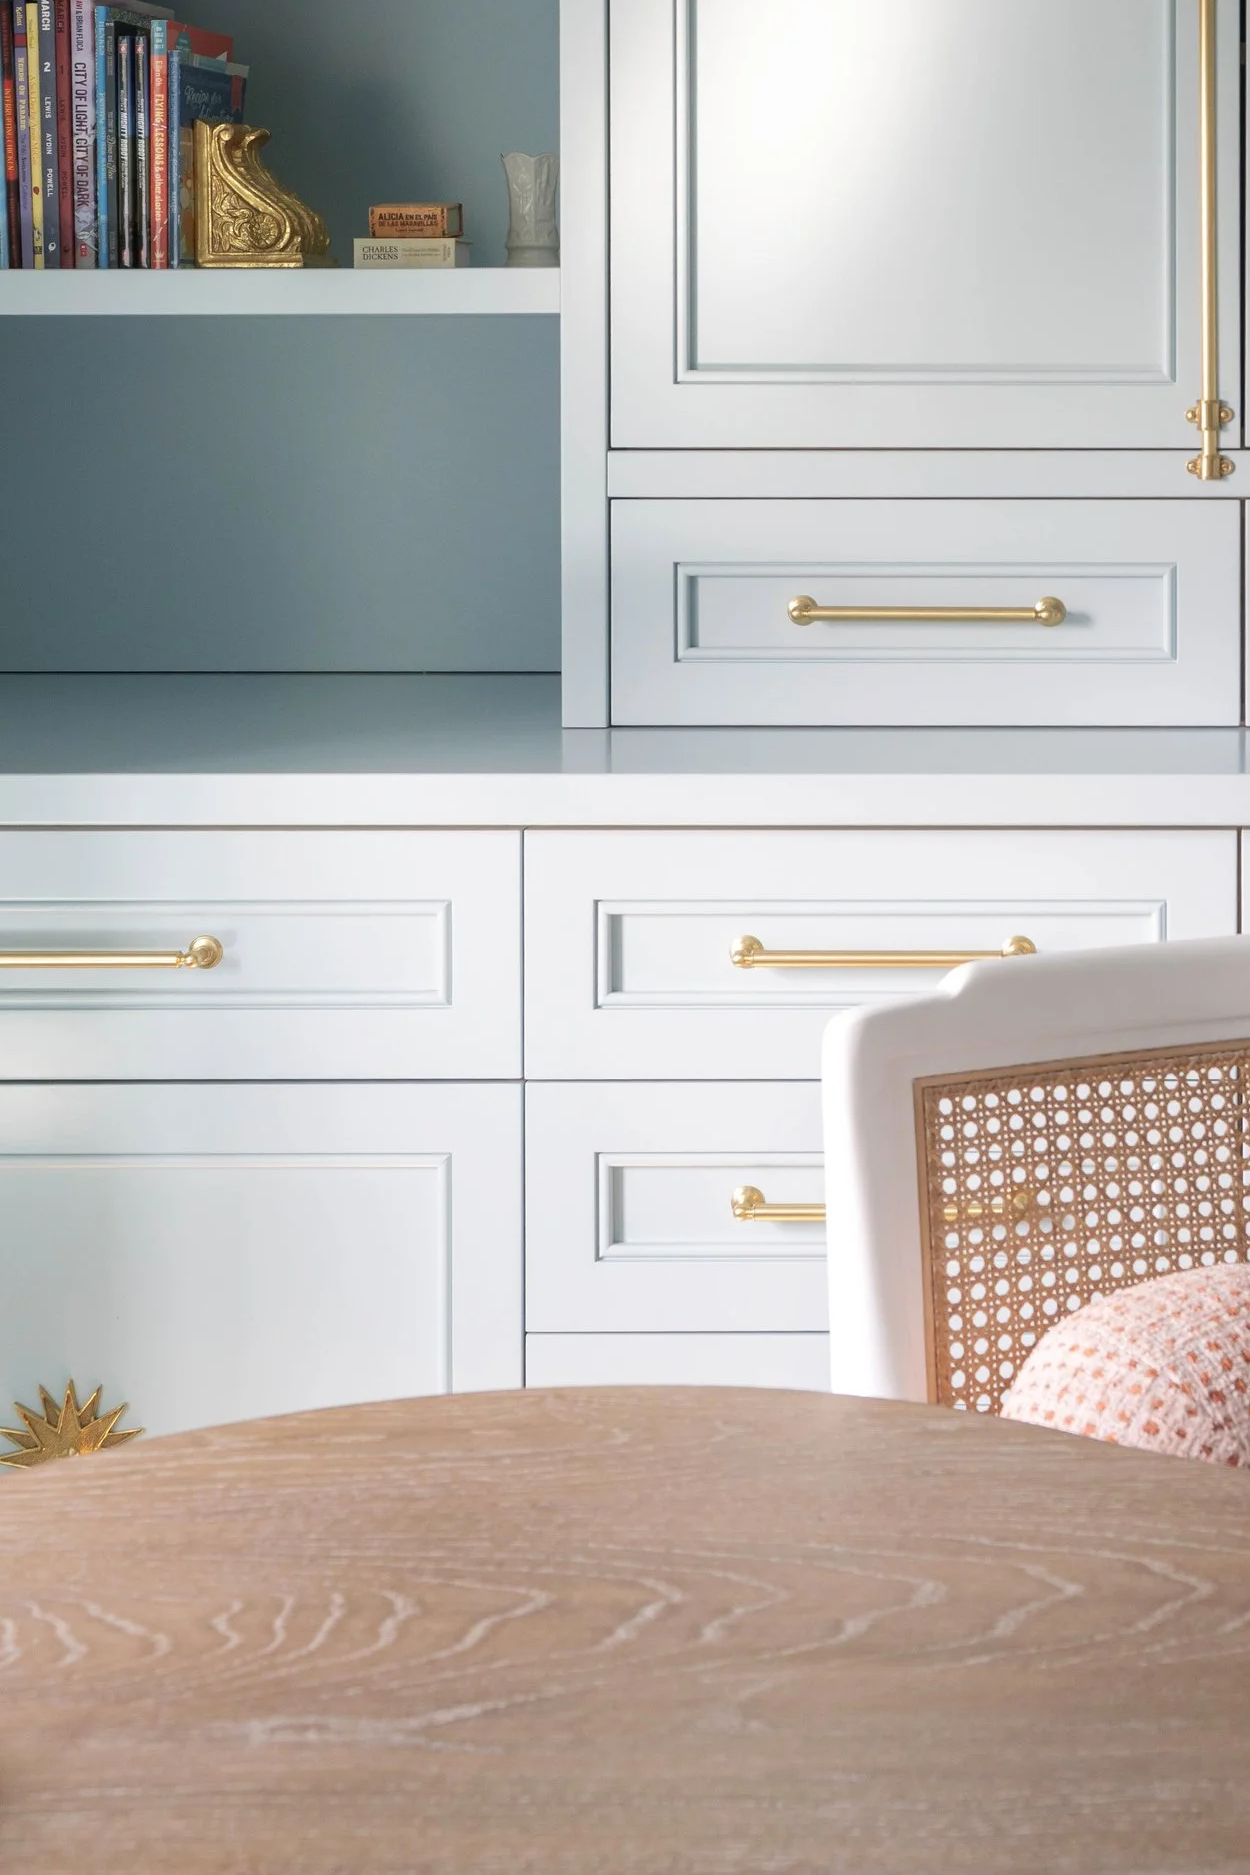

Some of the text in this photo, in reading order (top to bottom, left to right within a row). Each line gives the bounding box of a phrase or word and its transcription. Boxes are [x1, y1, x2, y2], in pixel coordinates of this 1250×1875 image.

[75, 0, 83, 10] AVI
[56, 0, 65, 34] MARCH
[75, 15, 83, 33] BRIAN
[75, 33, 84, 52] FLOCA
[43, 62, 51, 72] 2
[155, 60, 163, 76] Ellen
[155, 77, 163, 86] Oh
[44, 97, 52, 119] LEWIS
[155, 93, 164, 123] FLYING
[74, 62, 90, 207] CITY OF LIGHT, CITY OF DARK
[137, 112, 145, 138] MIGHTY
[45, 132, 53, 155] AYDIN
[155, 127, 164, 165] LESSONS
[46, 168, 54, 198] POWELL
[154, 173, 163, 194] other
[154, 195, 163, 222] stories
[378, 213, 404, 221] ALICIA
[423, 212, 438, 220] PAÍS
